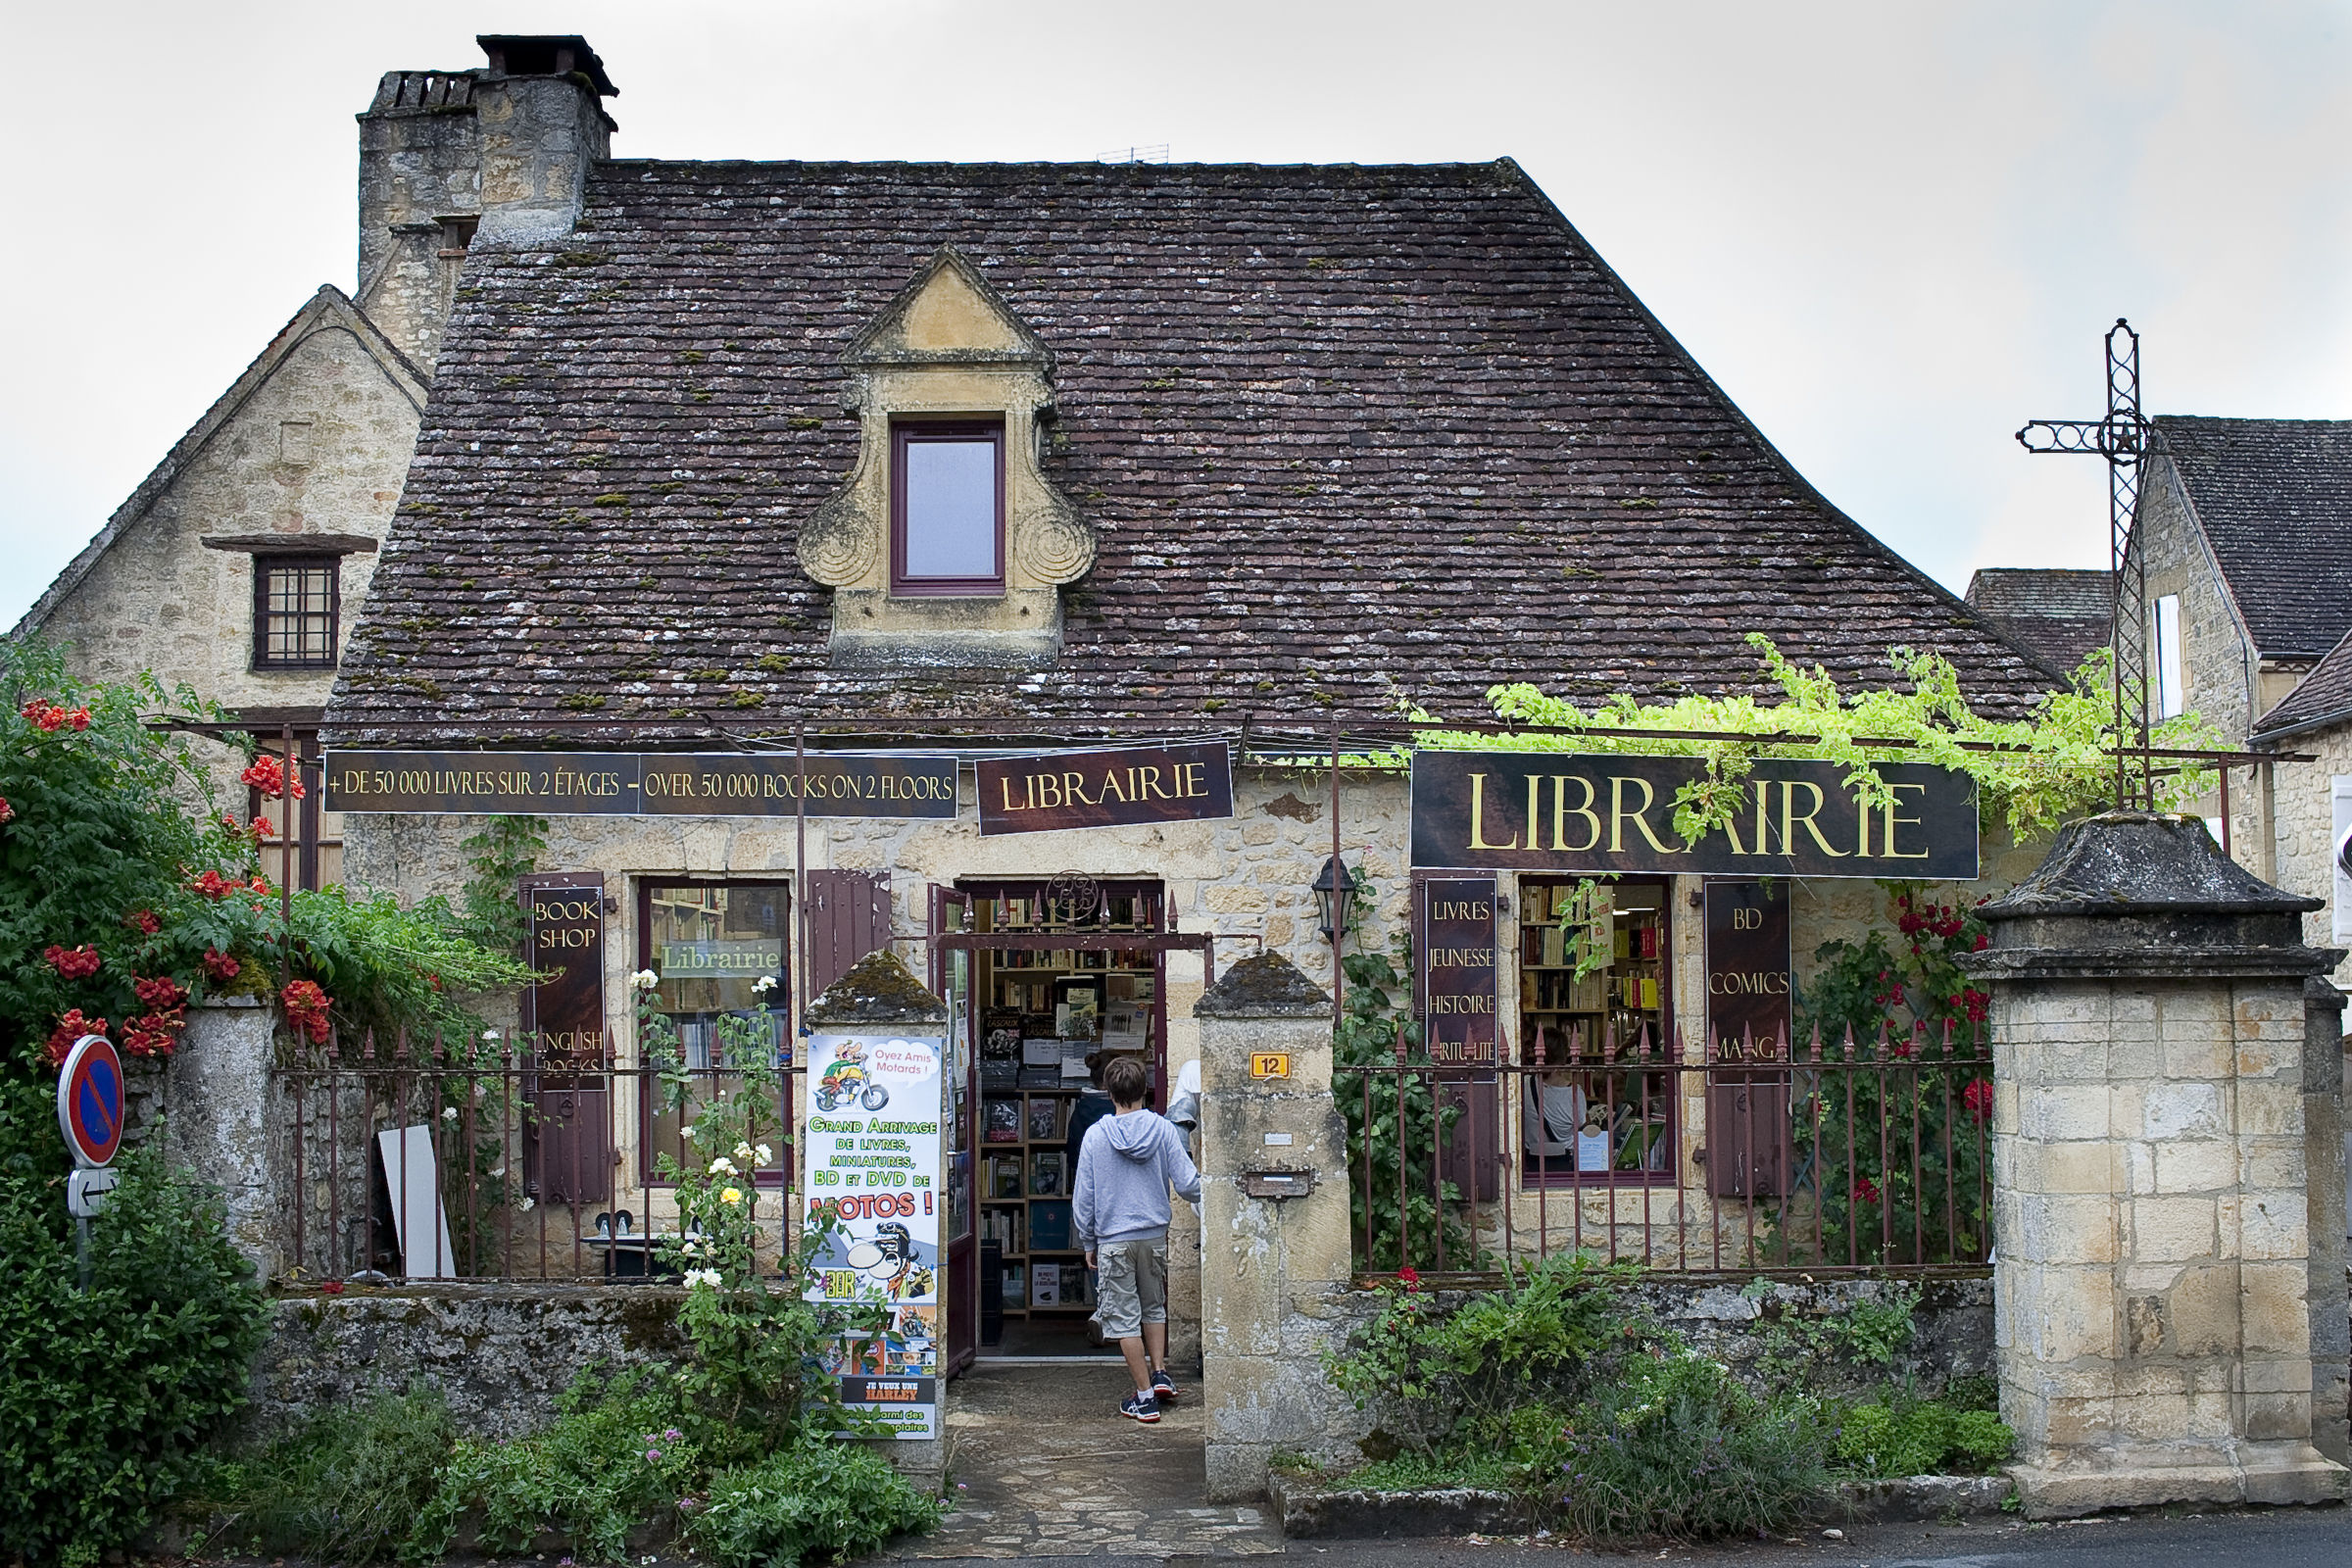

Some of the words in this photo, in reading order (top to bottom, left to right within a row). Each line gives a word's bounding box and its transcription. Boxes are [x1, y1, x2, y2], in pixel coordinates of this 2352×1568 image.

[344, 770, 369, 795] DE
[374, 770, 394, 795] 50
[399, 770, 430, 795] 000
[435, 770, 494, 795] LIVRES
[498, 771, 534, 795] SUR
[539, 771, 550, 795] 2
[554, 766, 619, 796] ÉTAGES
[645, 772, 696, 797] OVER
[702, 773, 722, 798] 50
[726, 773, 759, 799] 000
[763, 774, 827, 800] BOOKS
[832, 775, 860, 800] ON
[865, 776, 876, 799] 2
[880, 775, 953, 801] FLOORS
[1001, 761, 1209, 811] LIBRAIRIE
[535, 901, 600, 921] BOOK
[1434, 902, 1490, 920] LIVRES
[1734, 907, 1763, 930] BD
[539, 929, 596, 949] SHOP
[662, 946, 780, 969] Librairie
[1429, 948, 1494, 972] JEUNESSE
[1708, 971, 1789, 995] COMICS
[1429, 995, 1495, 1014] HISTOIRE
[541, 1032, 603, 1051] NGLISH
[1430, 1038, 1495, 1060] IRITULITÉ
[875, 1050, 902, 1061] Oyez
[906, 1053, 931, 1063] Amis
[1261, 1057, 1280, 1074] 12
[876, 1062, 921, 1074] Motards
[809, 1116, 862, 1133] GRAND
[867, 1117, 937, 1134] ARRIVAGE
[836, 1139, 854, 1151] DE
[860, 1139, 911, 1152] LIVRES,
[830, 1155, 916, 1170] MINIATURES,
[814, 1171, 839, 1186] BD
[847, 1175, 860, 1186] ET
[866, 1172, 906, 1187] DVD
[913, 1175, 930, 1187] DE
[865, 1390, 918, 1401] HARLEY
[880, 1410, 904, 1420] armi
[906, 1410, 924, 1420] des
